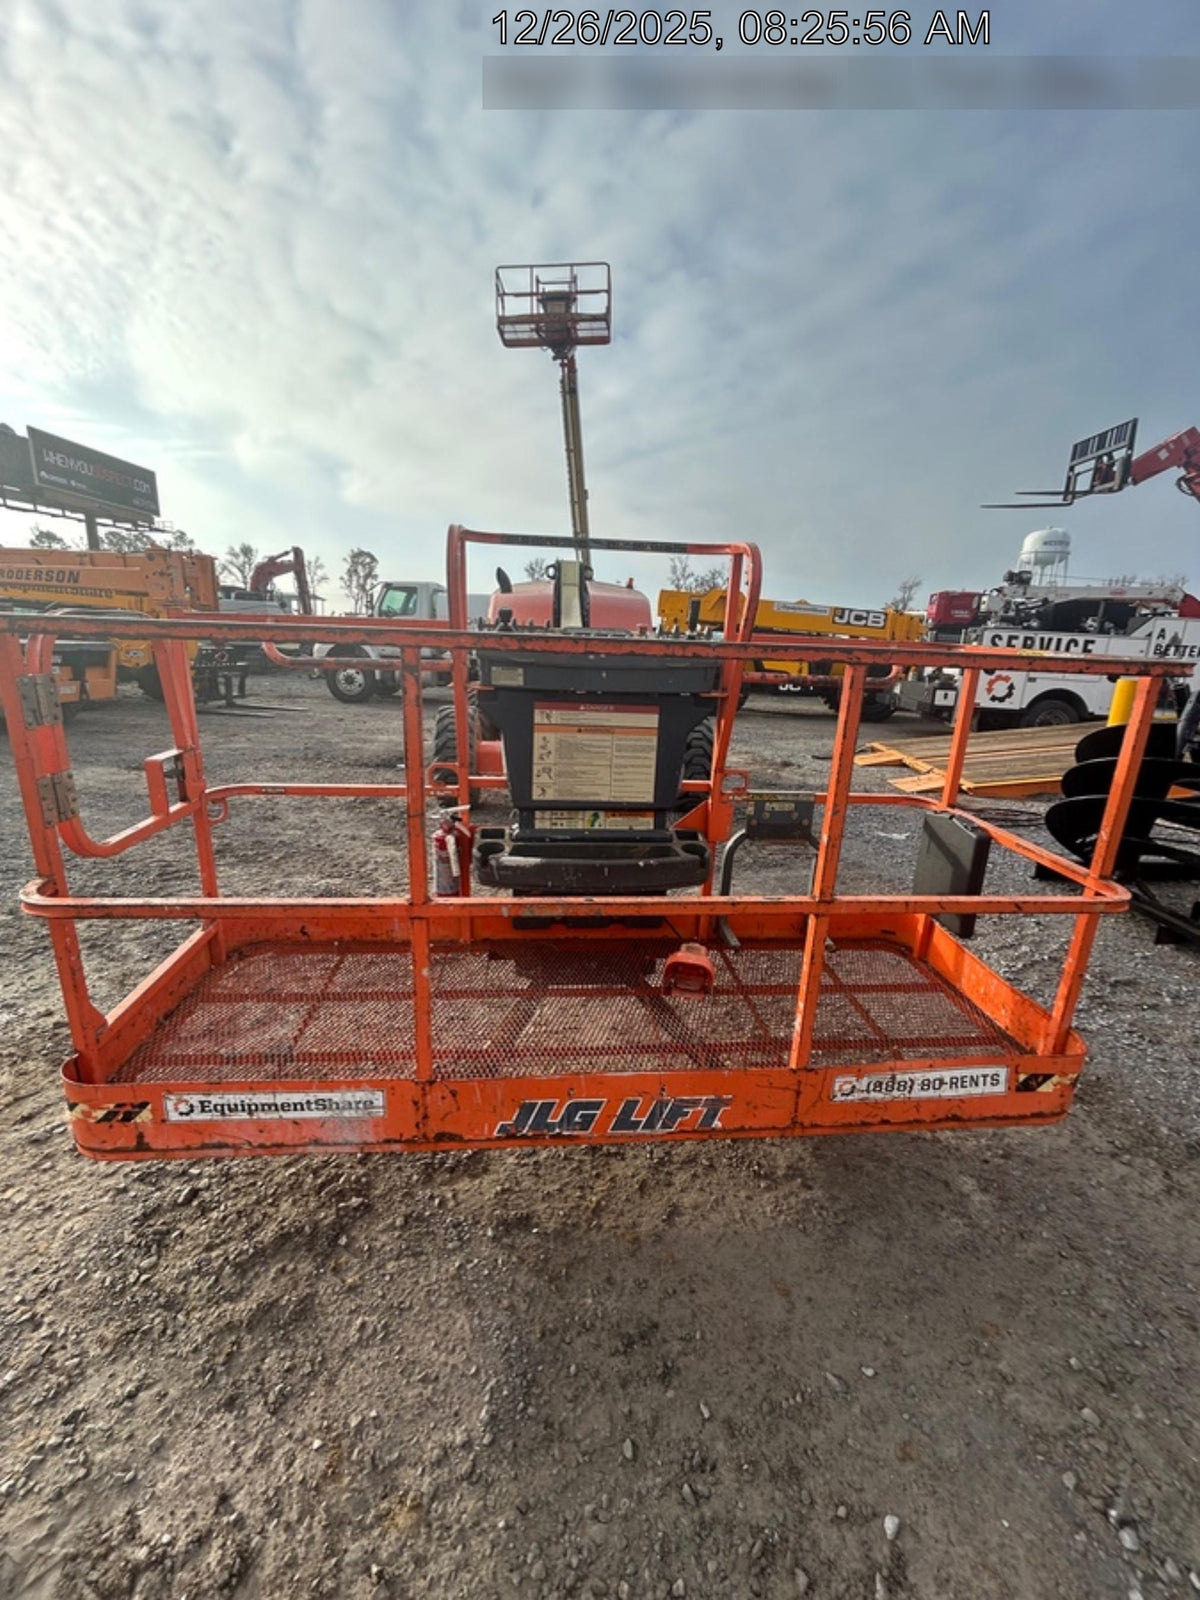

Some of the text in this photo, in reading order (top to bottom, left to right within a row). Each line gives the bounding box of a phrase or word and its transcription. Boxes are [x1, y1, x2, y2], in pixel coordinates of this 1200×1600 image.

[834, 608, 886, 628] JCB
[990, 633, 1096, 654] SERVICE
[1157, 627, 1166, 640] A
[865, 1073, 1000, 1095] (888) 80-RENTS
[199, 1096, 377, 1117] EquipmentShare
[493, 1095, 733, 1137] JLG LIFT
